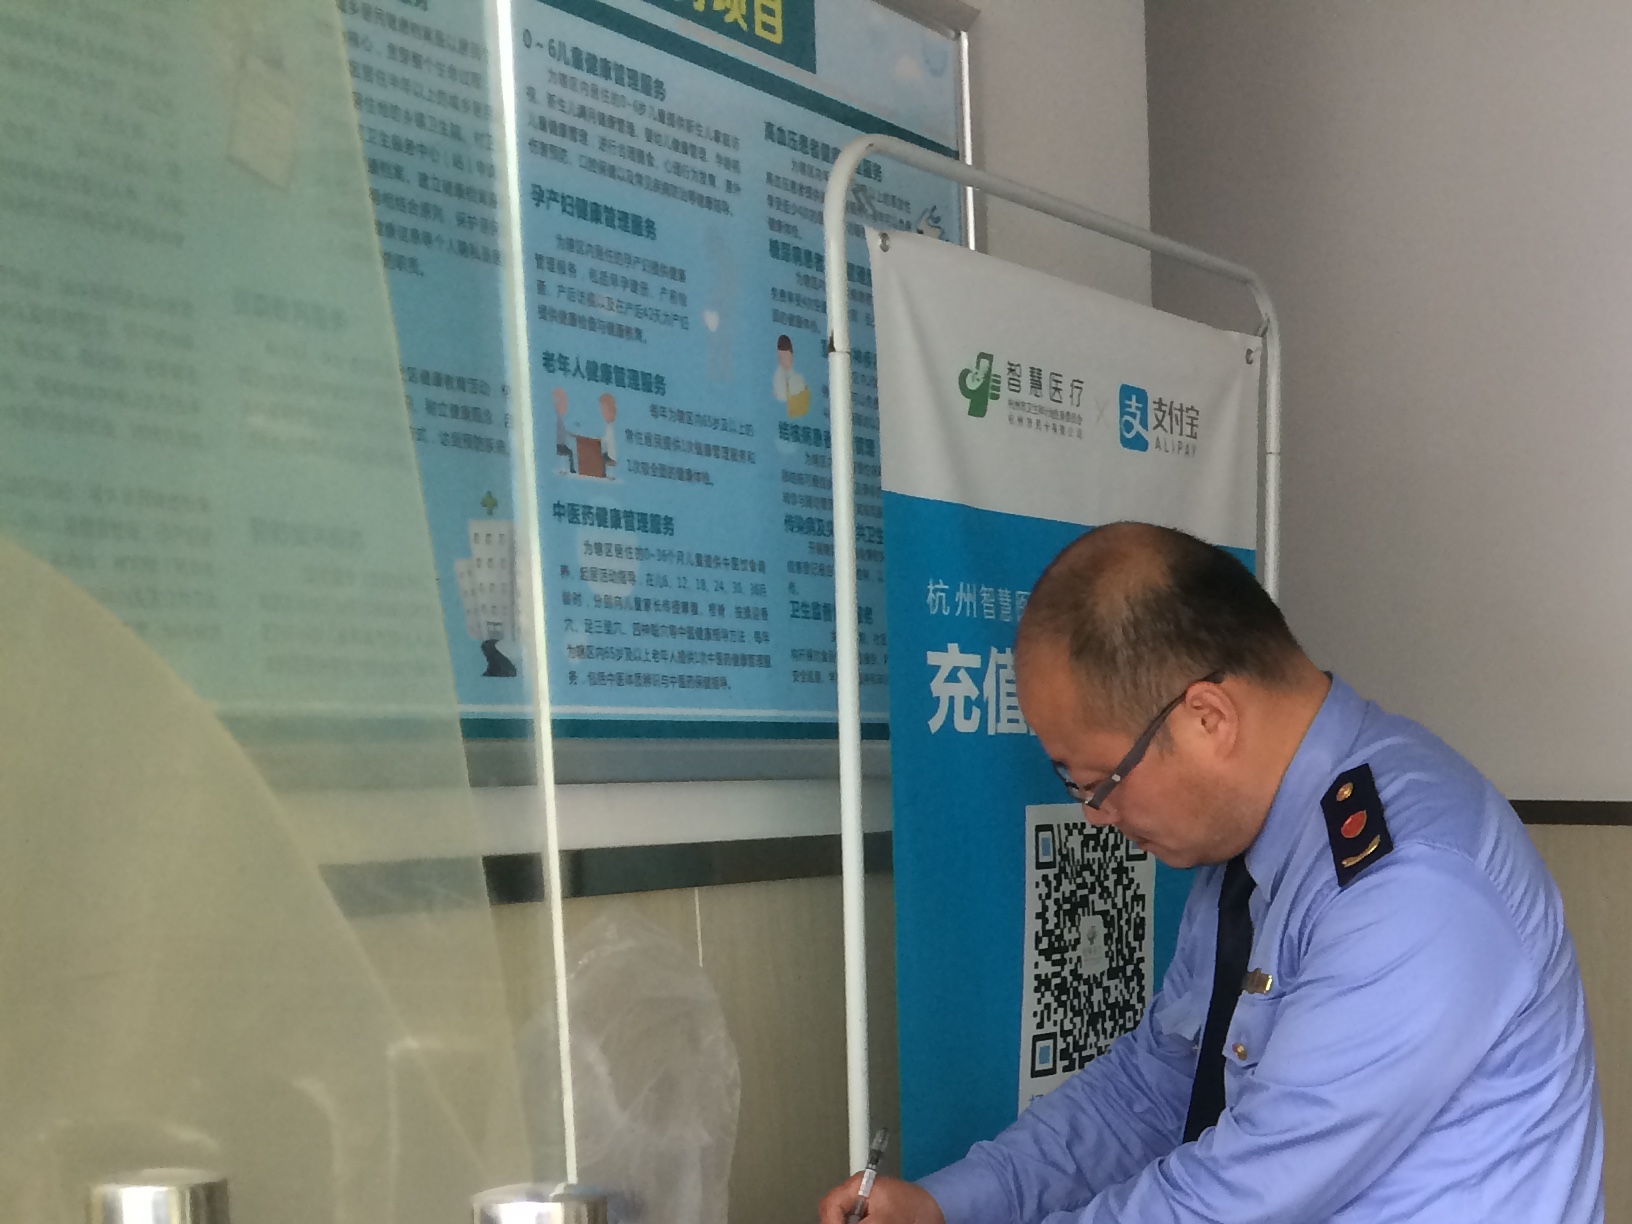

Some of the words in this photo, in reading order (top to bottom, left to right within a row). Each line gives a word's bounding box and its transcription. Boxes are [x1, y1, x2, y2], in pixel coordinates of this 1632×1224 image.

[542, 351, 667, 397] 老年人健康管理服务
[1006, 360, 1084, 408] 智慧医疗
[1152, 397, 1200, 440] 支付宝
[1154, 437, 1197, 458] ALIPAY
[552, 500, 675, 537] 中医药健康管理服务
[926, 643, 1030, 736] 充值
